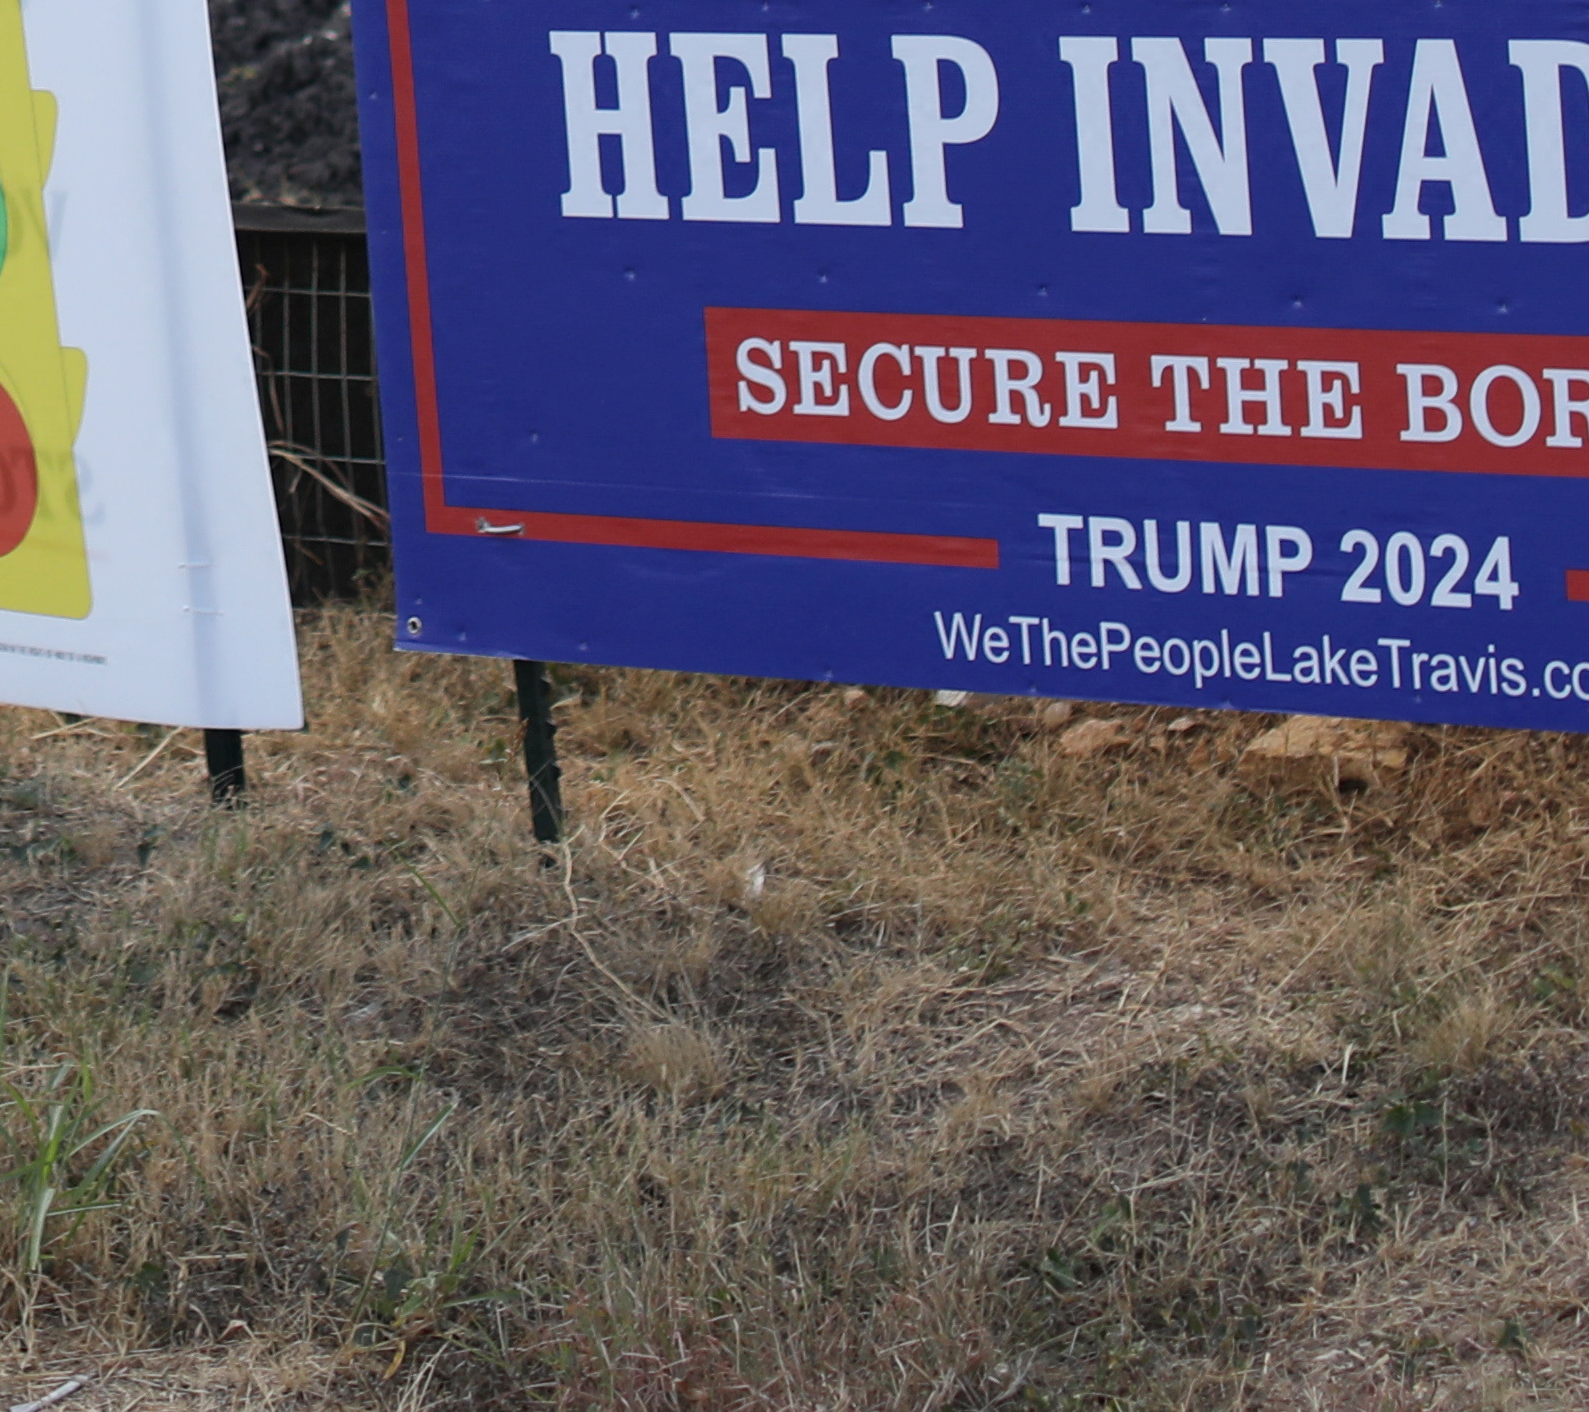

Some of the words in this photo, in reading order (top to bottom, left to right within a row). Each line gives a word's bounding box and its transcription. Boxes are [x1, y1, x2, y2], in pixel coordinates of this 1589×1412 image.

[548, 30, 1000, 230] HELP
[735, 337, 1119, 433] SECURE
[1149, 354, 1364, 440] THE
[1037, 513, 1314, 598] TRUMP
[1340, 529, 1520, 611] 2024
